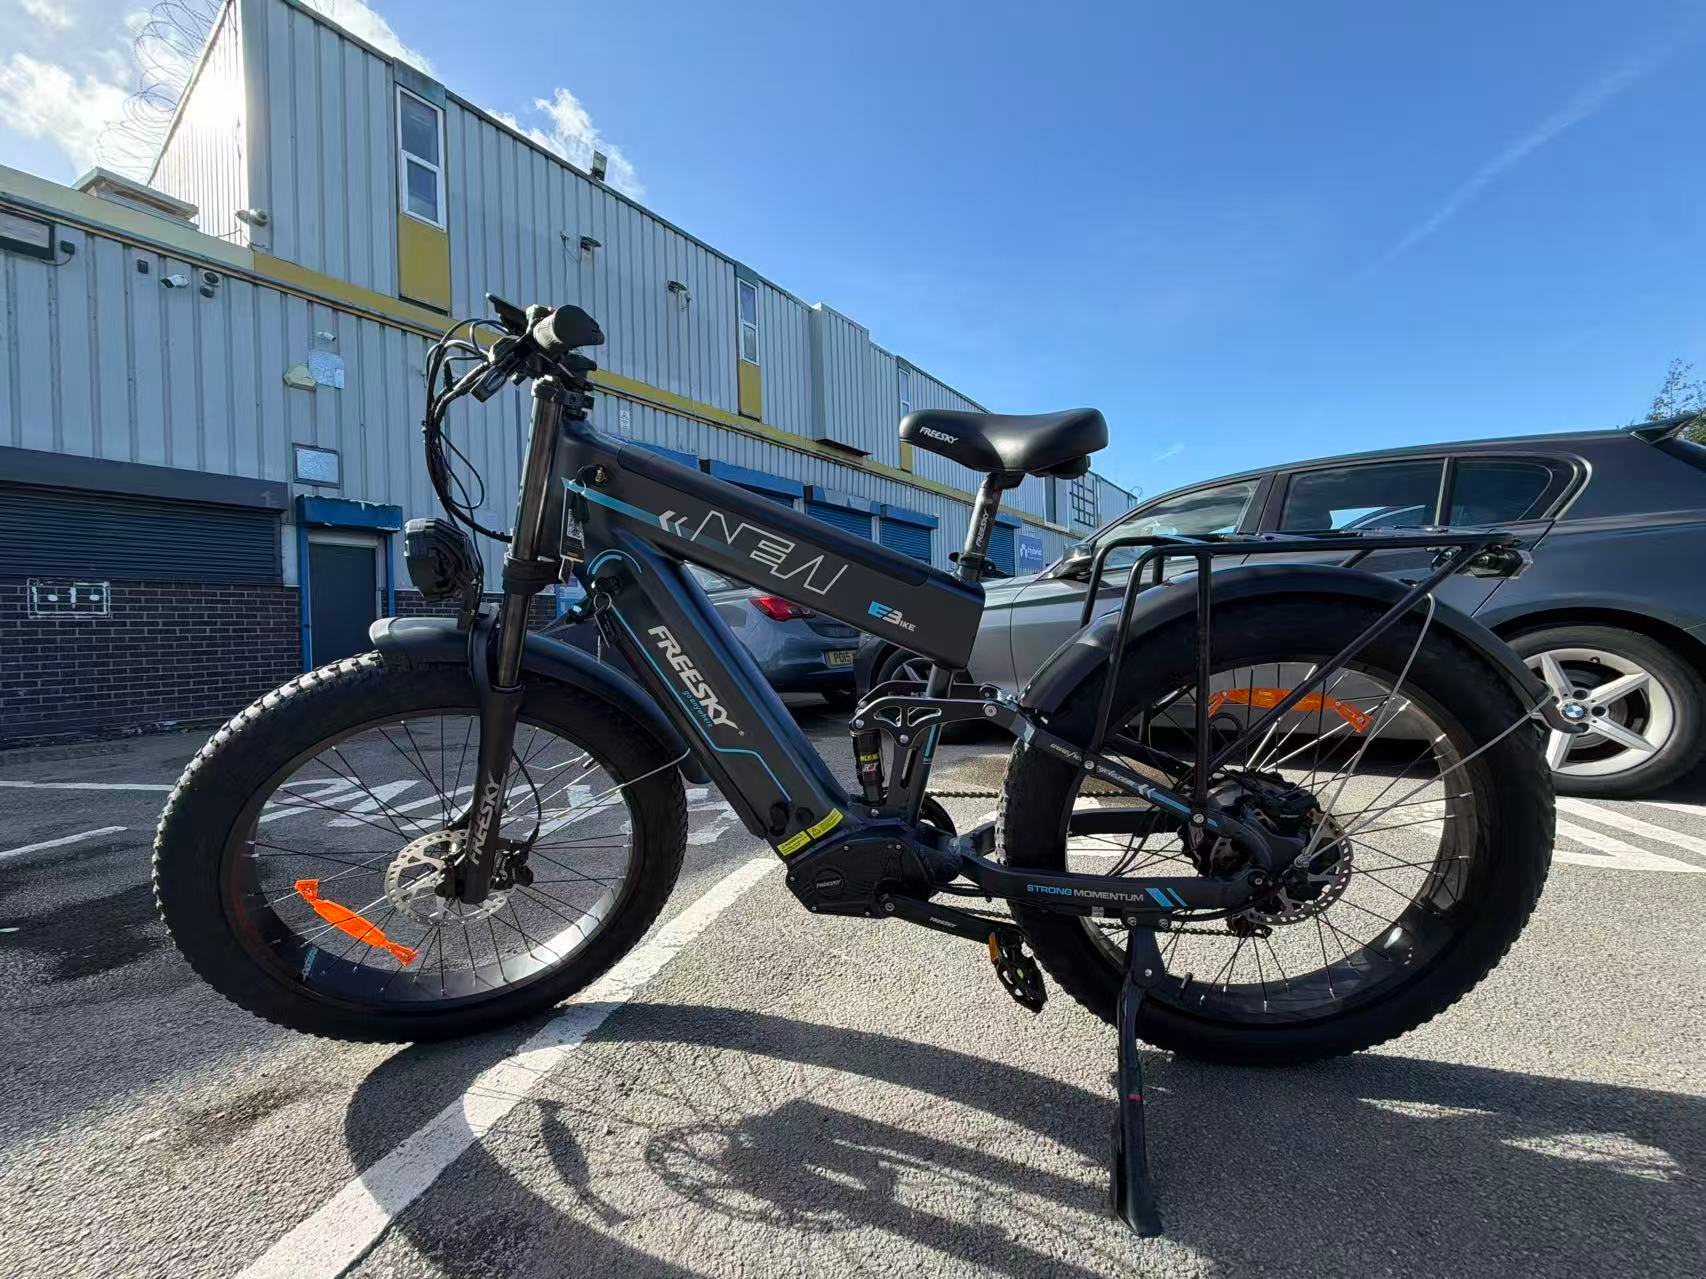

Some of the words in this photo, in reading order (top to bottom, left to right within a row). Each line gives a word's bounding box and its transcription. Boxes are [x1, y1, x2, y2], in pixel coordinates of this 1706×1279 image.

[920, 426, 959, 444] FREESKY
[976, 507, 989, 547] FREESKY
[648, 625, 740, 730] FREESKY
[470, 768, 500, 865] FREESKY
[1026, 884, 1073, 896] STRONG
[1073, 889, 1144, 902] MOMENTUM
